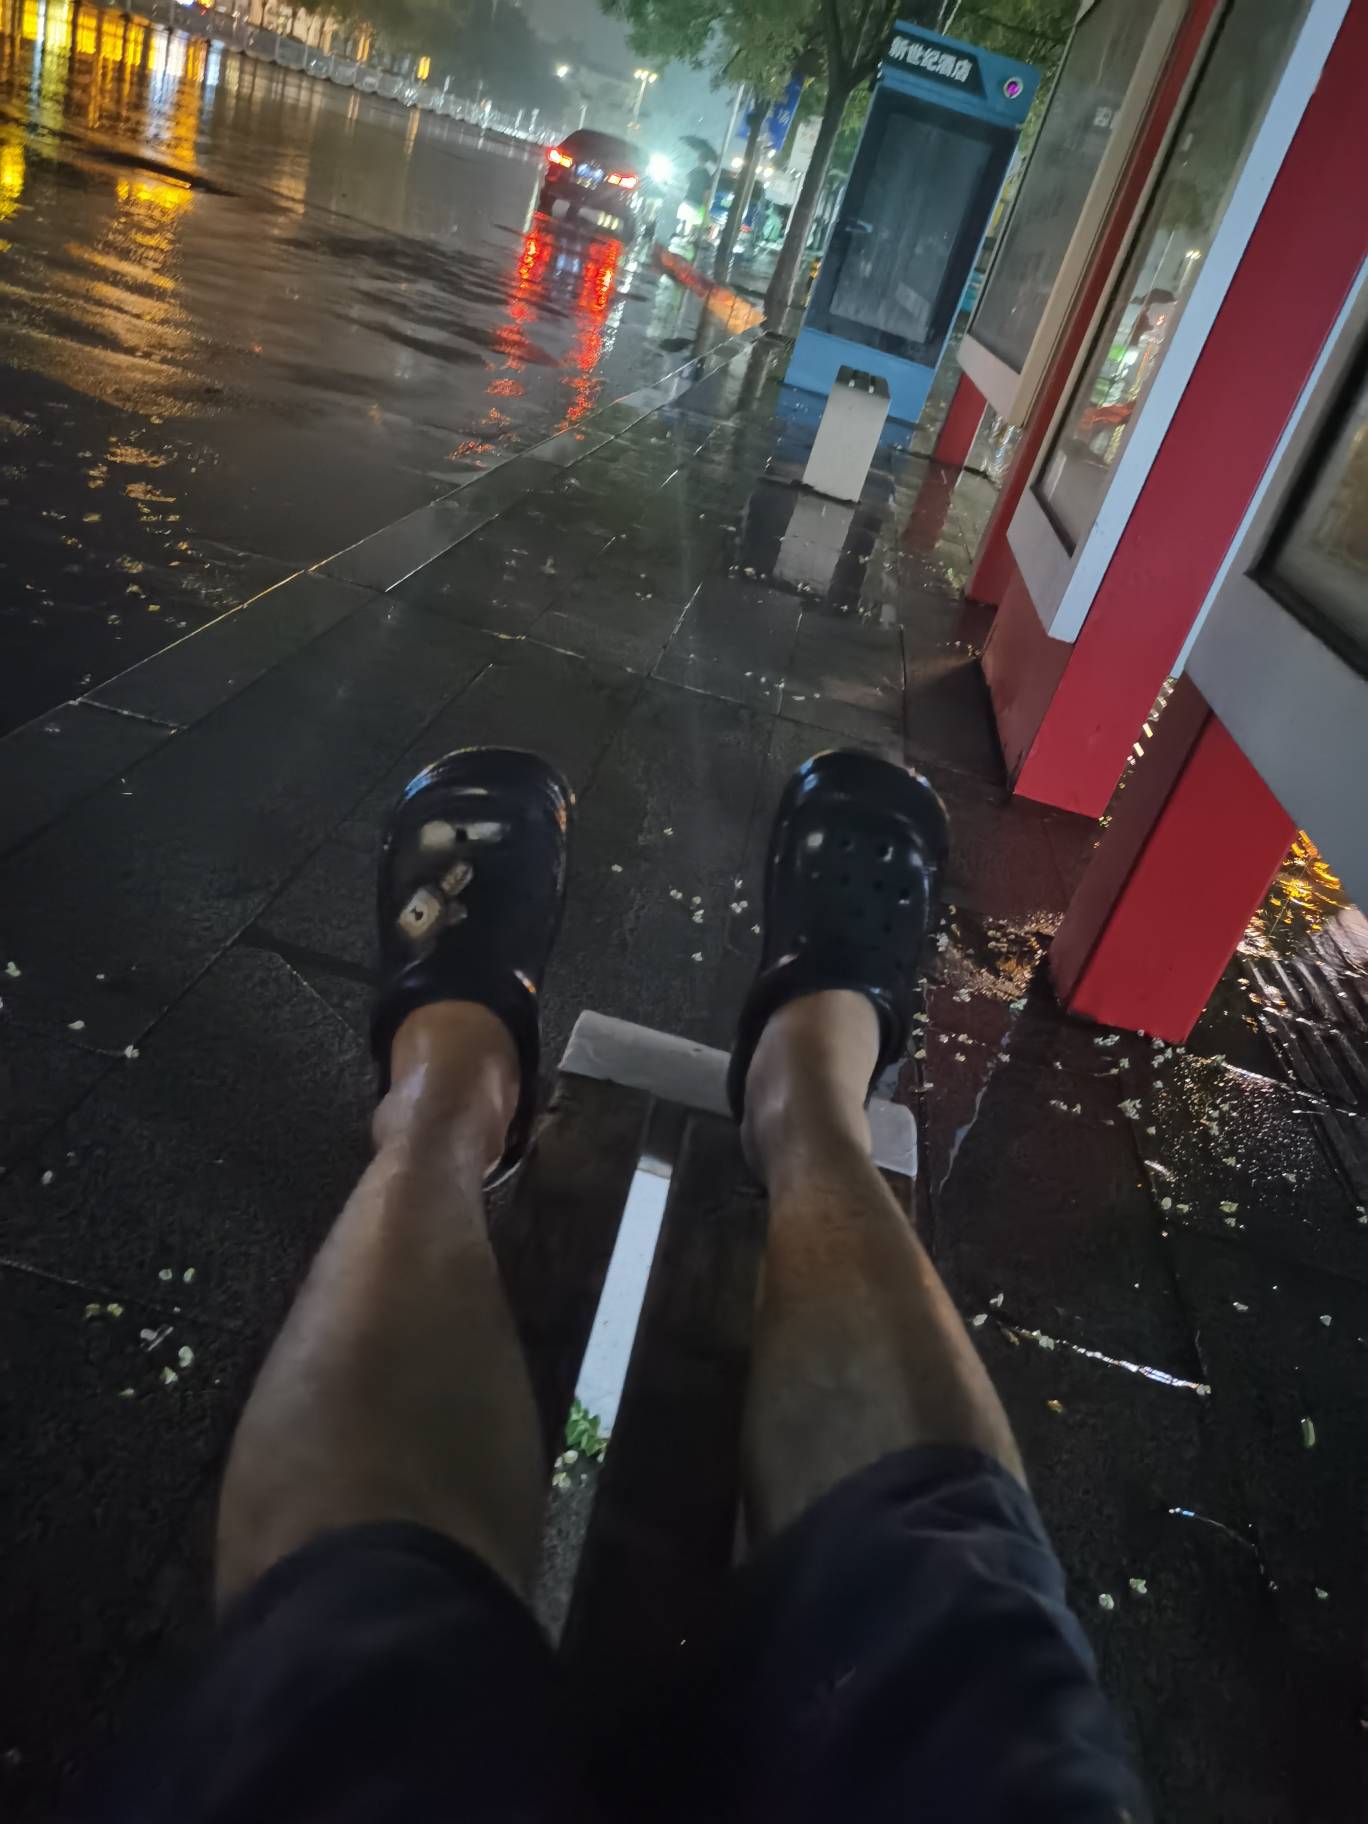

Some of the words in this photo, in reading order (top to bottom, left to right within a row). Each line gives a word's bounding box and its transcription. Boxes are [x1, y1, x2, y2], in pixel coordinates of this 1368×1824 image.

[888, 36, 973, 83] 新世纪酒店
